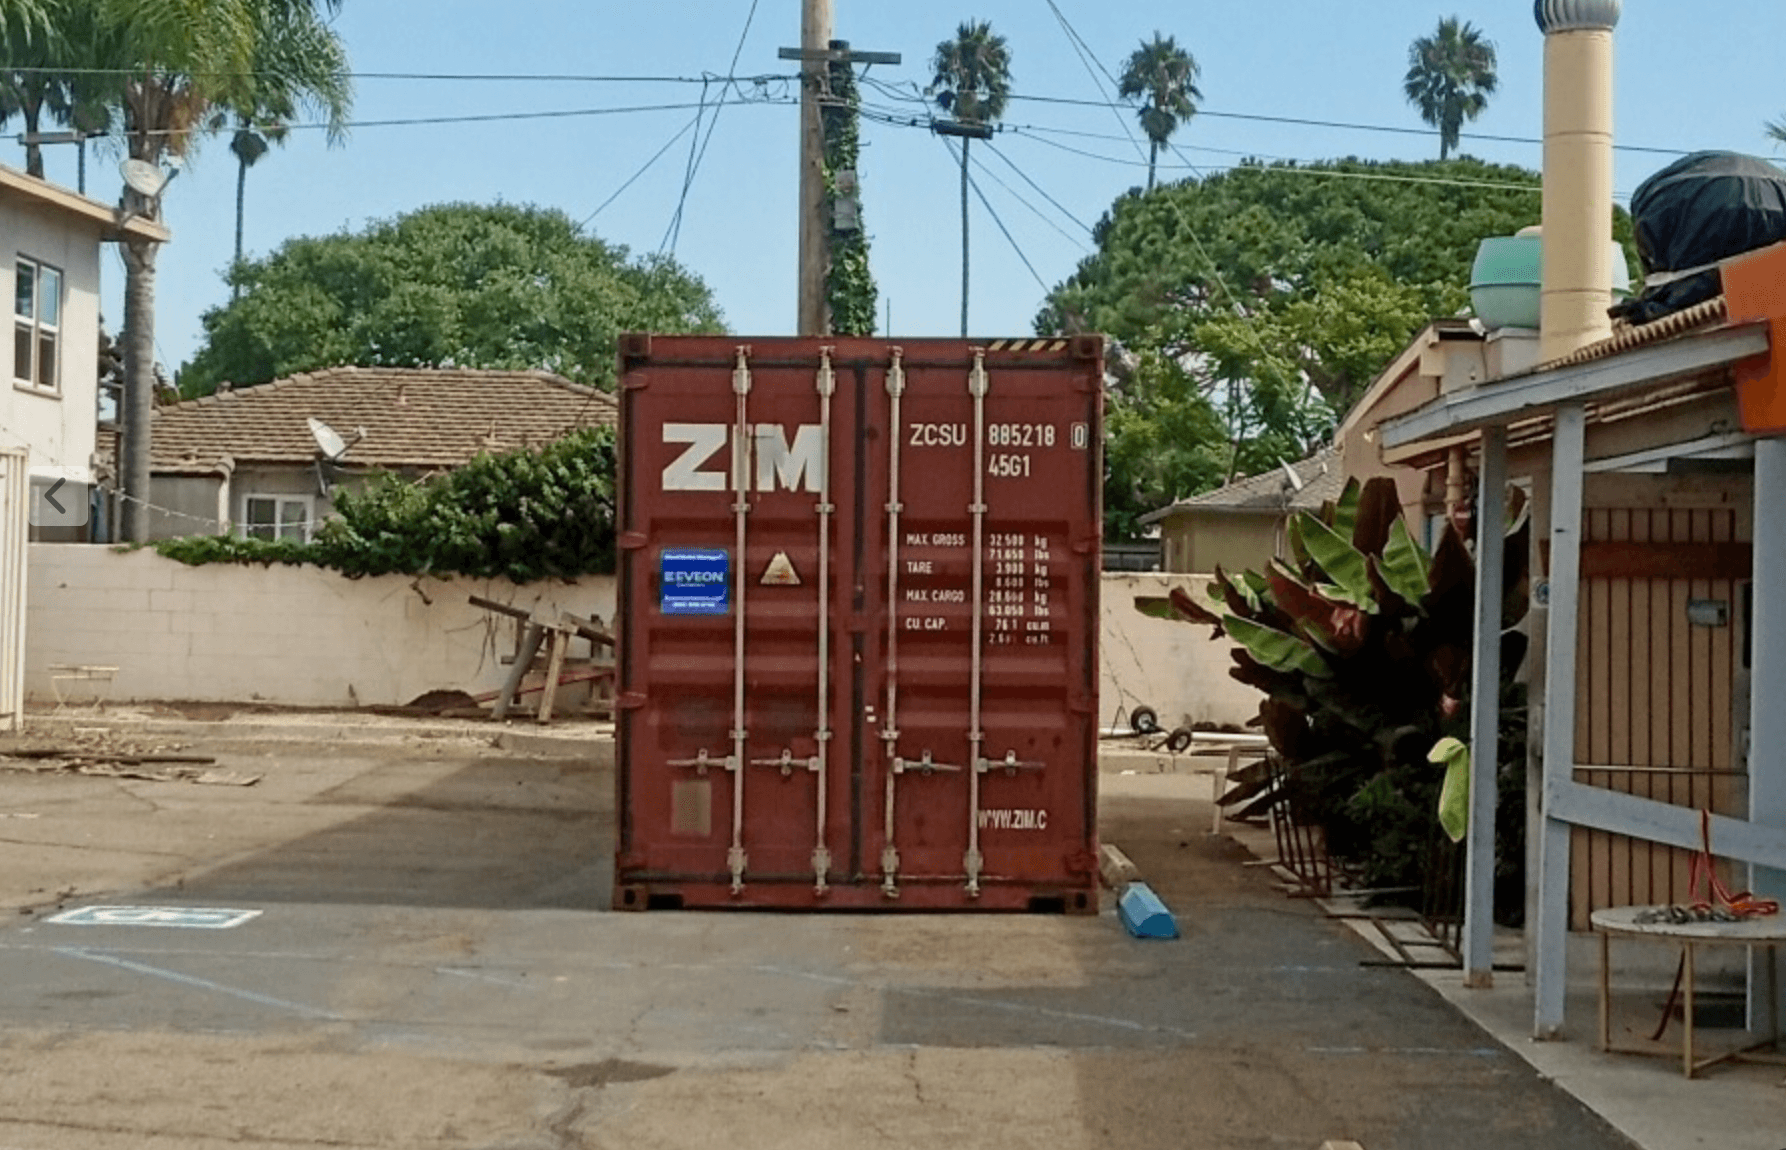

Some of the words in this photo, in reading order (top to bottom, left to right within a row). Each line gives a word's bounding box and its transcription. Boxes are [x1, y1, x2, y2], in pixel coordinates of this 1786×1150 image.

[909, 423, 967, 446] ZCSU
[988, 423, 1055, 446] 885218
[662, 422, 829, 492] ZIM
[988, 454, 1031, 477] 45G1
[932, 533, 966, 546] GROSS
[1034, 533, 1048, 550] kg
[1034, 548, 1050, 560] lbs
[907, 561, 933, 575] TARE
[1034, 562, 1048, 577] kg
[1034, 577, 1050, 588] lbs
[932, 589, 965, 603] CARGO
[1034, 590, 1047, 606] kg
[1034, 604, 1050, 617] lbs
